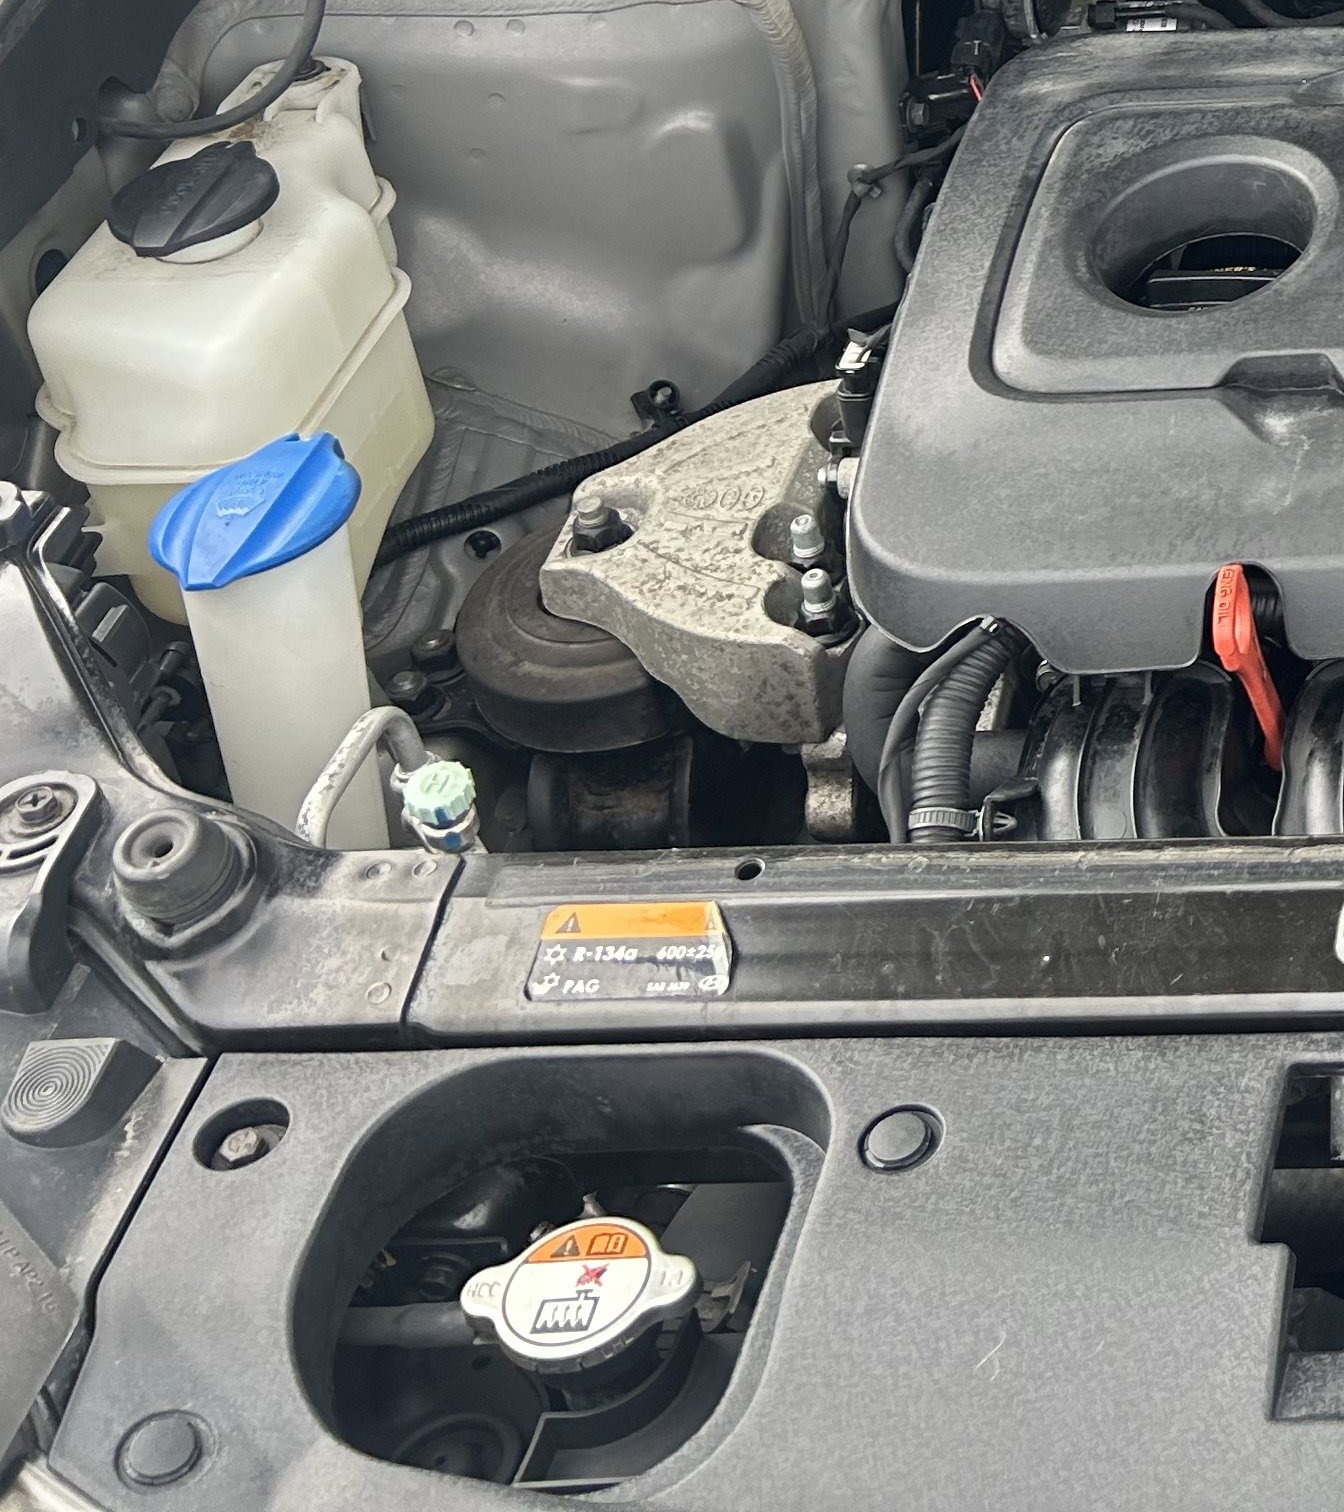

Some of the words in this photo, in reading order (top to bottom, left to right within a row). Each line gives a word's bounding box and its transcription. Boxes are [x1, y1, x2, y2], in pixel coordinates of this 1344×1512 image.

[1220, 568, 1238, 598] ENG
[1217, 601, 1232, 625] OIL
[573, 946, 639, 962] R-134a
[562, 979, 600, 994] PAG
